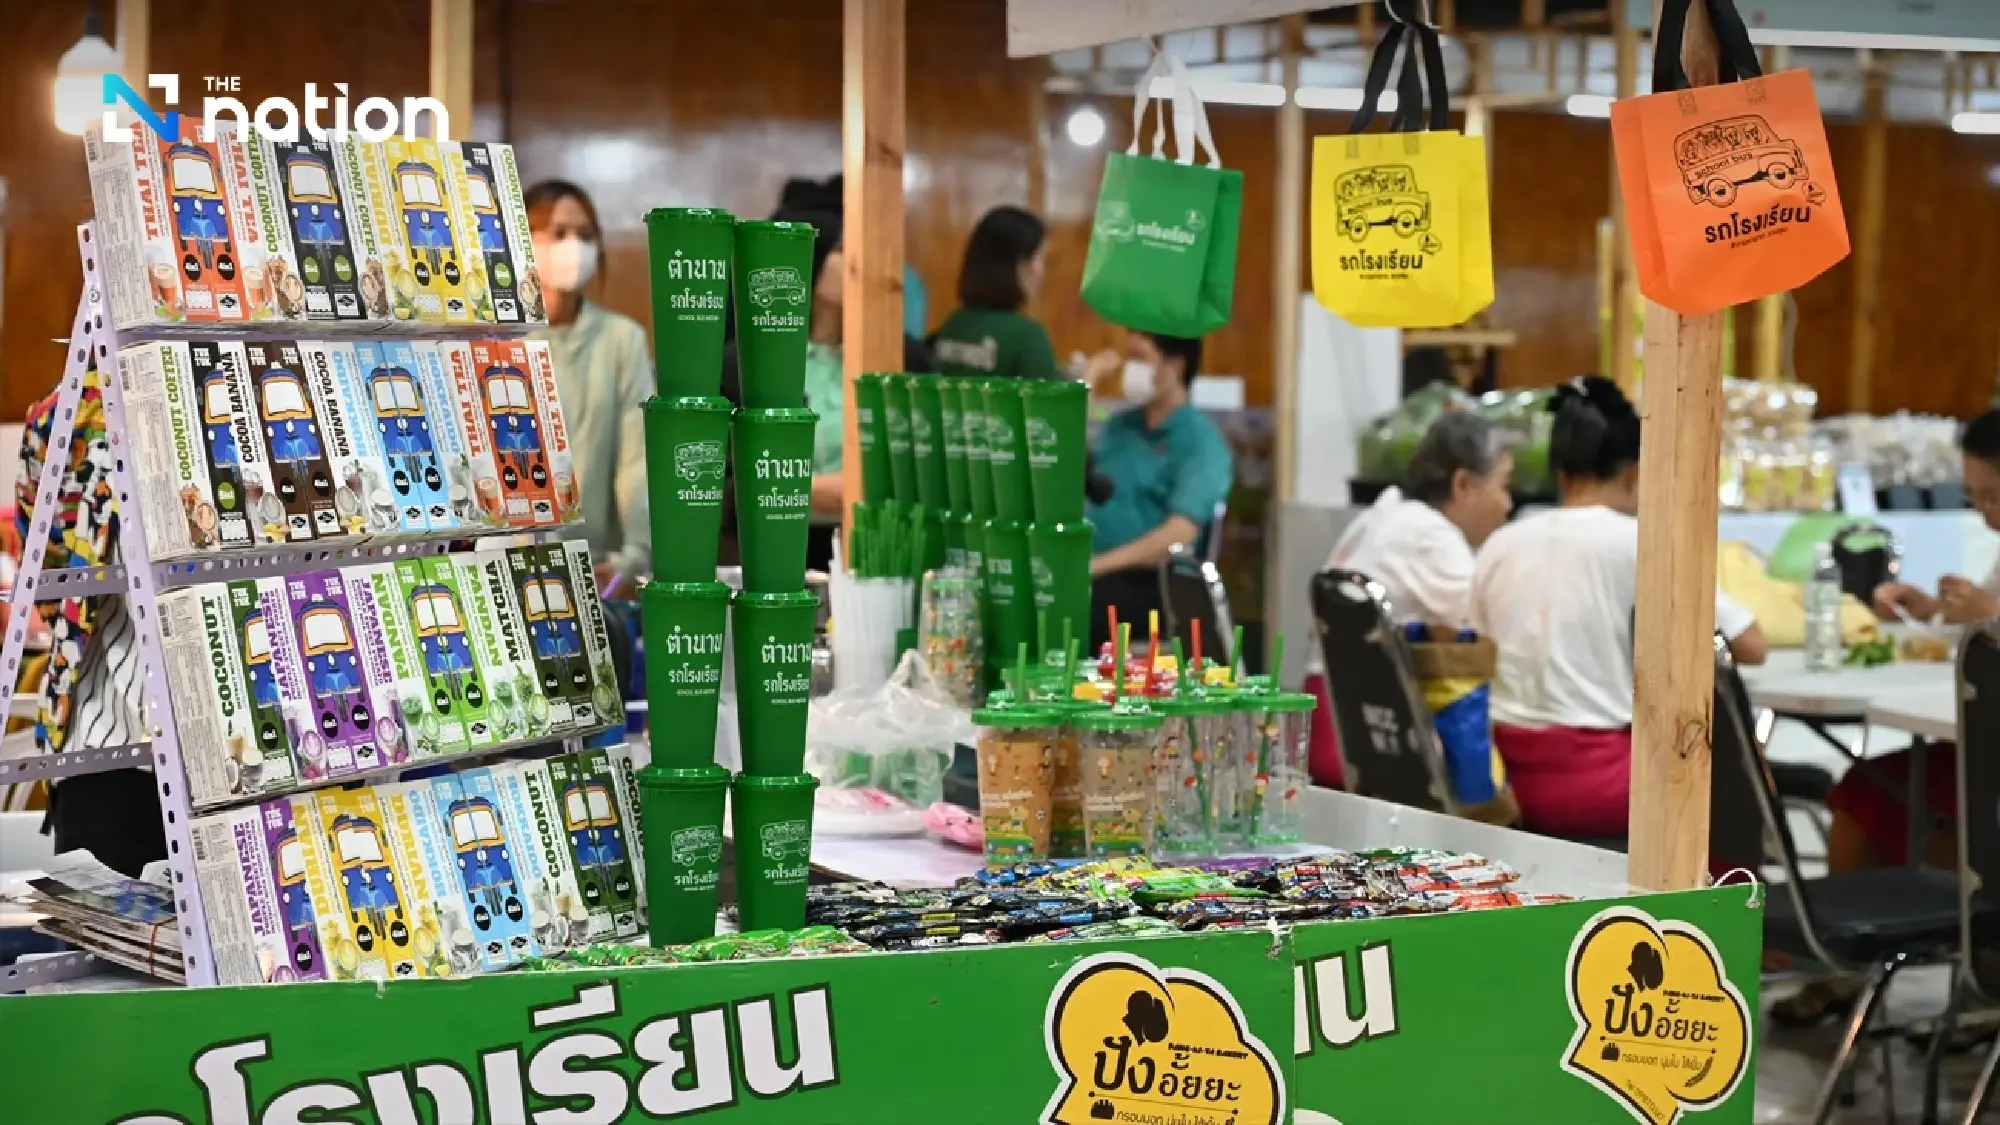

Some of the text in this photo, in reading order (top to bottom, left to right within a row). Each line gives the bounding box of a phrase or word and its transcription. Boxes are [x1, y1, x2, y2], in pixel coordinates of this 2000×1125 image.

[131, 121, 158, 240] THAI TEA
[242, 195, 258, 243] TEA
[255, 183, 278, 252] COCONUT
[358, 204, 377, 255] COFFEE
[503, 148, 535, 263] COCONUT COFFEE
[1704, 203, 1811, 243] รถโรงเรียน
[668, 249, 726, 280] ตำนาน
[671, 288, 723, 309] รถโรงเรียน
[1340, 249, 1423, 271] รถโรงเรียน
[160, 346, 192, 481] COCONUT COFFEE
[221, 352, 255, 463] COCOA BANANA
[314, 351, 350, 457] COCOA BANANA
[451, 349, 481, 457] THAI TEA
[538, 348, 567, 452] THAI TEA
[756, 449, 811, 480] ตำนาน
[260, 591, 292, 701] JAPANESE
[362, 577, 393, 684] JAPANESE
[371, 574, 410, 680] PANDAN
[466, 565, 503, 667] PANDAN
[486, 560, 520, 662] MATCHA
[578, 551, 607, 651] MATCHA
[666, 625, 722, 655] ตำนาน
[201, 596, 235, 718] COCONUT
[292, 805, 329, 917] DURIAN
[390, 794, 429, 899] DURIAN
[524, 771, 561, 878] COCONUT
[234, 823, 266, 937] JAPANESE
[1094, 1035, 1242, 1101] ปังอั้ยยะ
